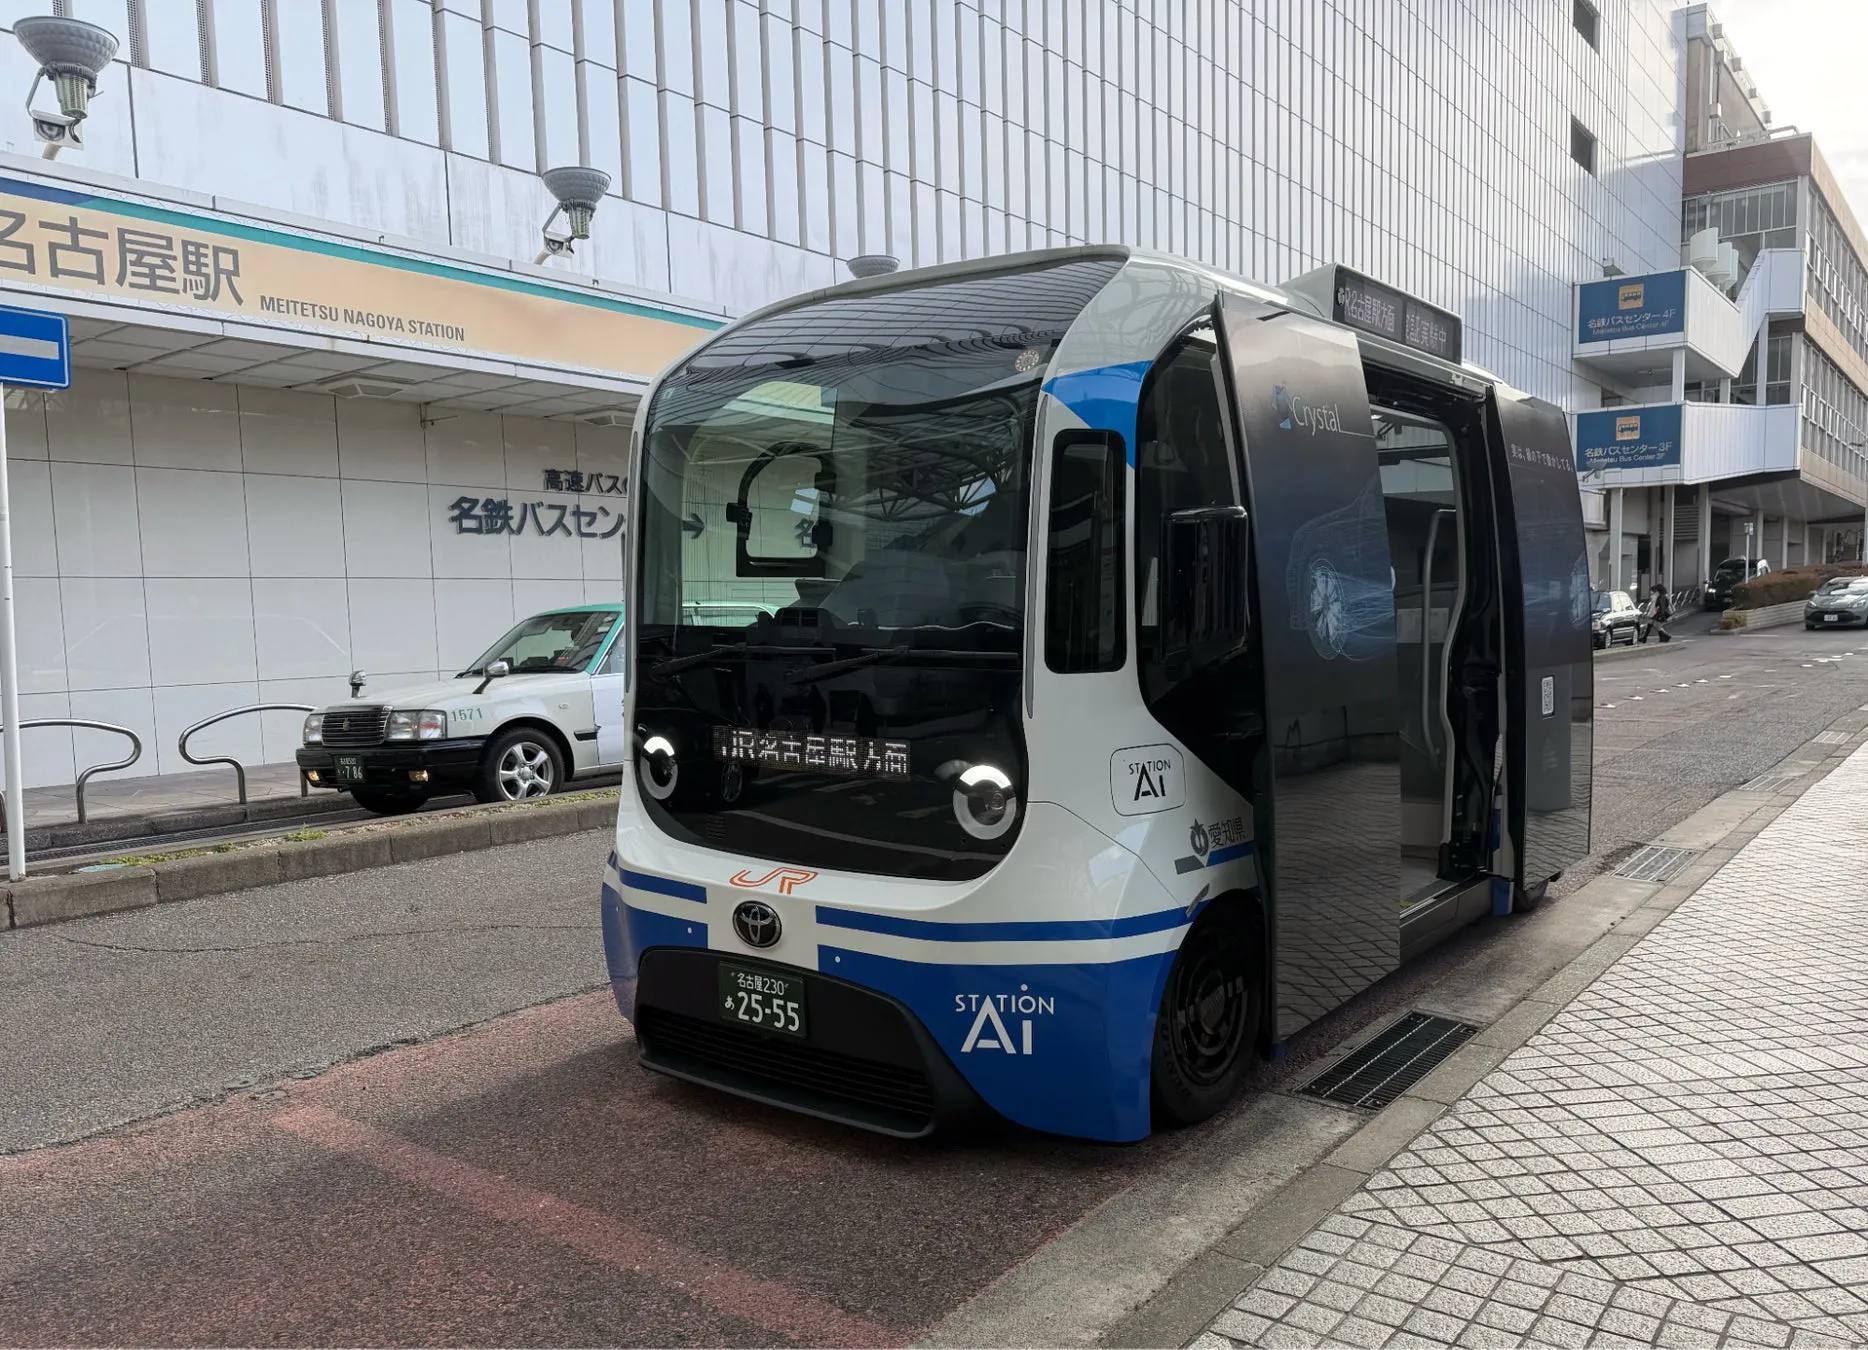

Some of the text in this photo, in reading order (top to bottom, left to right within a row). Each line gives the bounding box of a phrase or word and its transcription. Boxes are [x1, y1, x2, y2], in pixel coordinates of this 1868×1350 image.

[260, 295, 465, 341] MEITETSU NAGOYA STATION
[1292, 396, 1341, 436] Crystal
[449, 497, 627, 539] 名鉄バスセン
[451, 708, 483, 722] 1571
[1128, 759, 1171, 775] STATION
[1208, 817, 1247, 848] 愛知県
[737, 991, 800, 1032] 25-55
[955, 993, 1054, 1015] STATION
